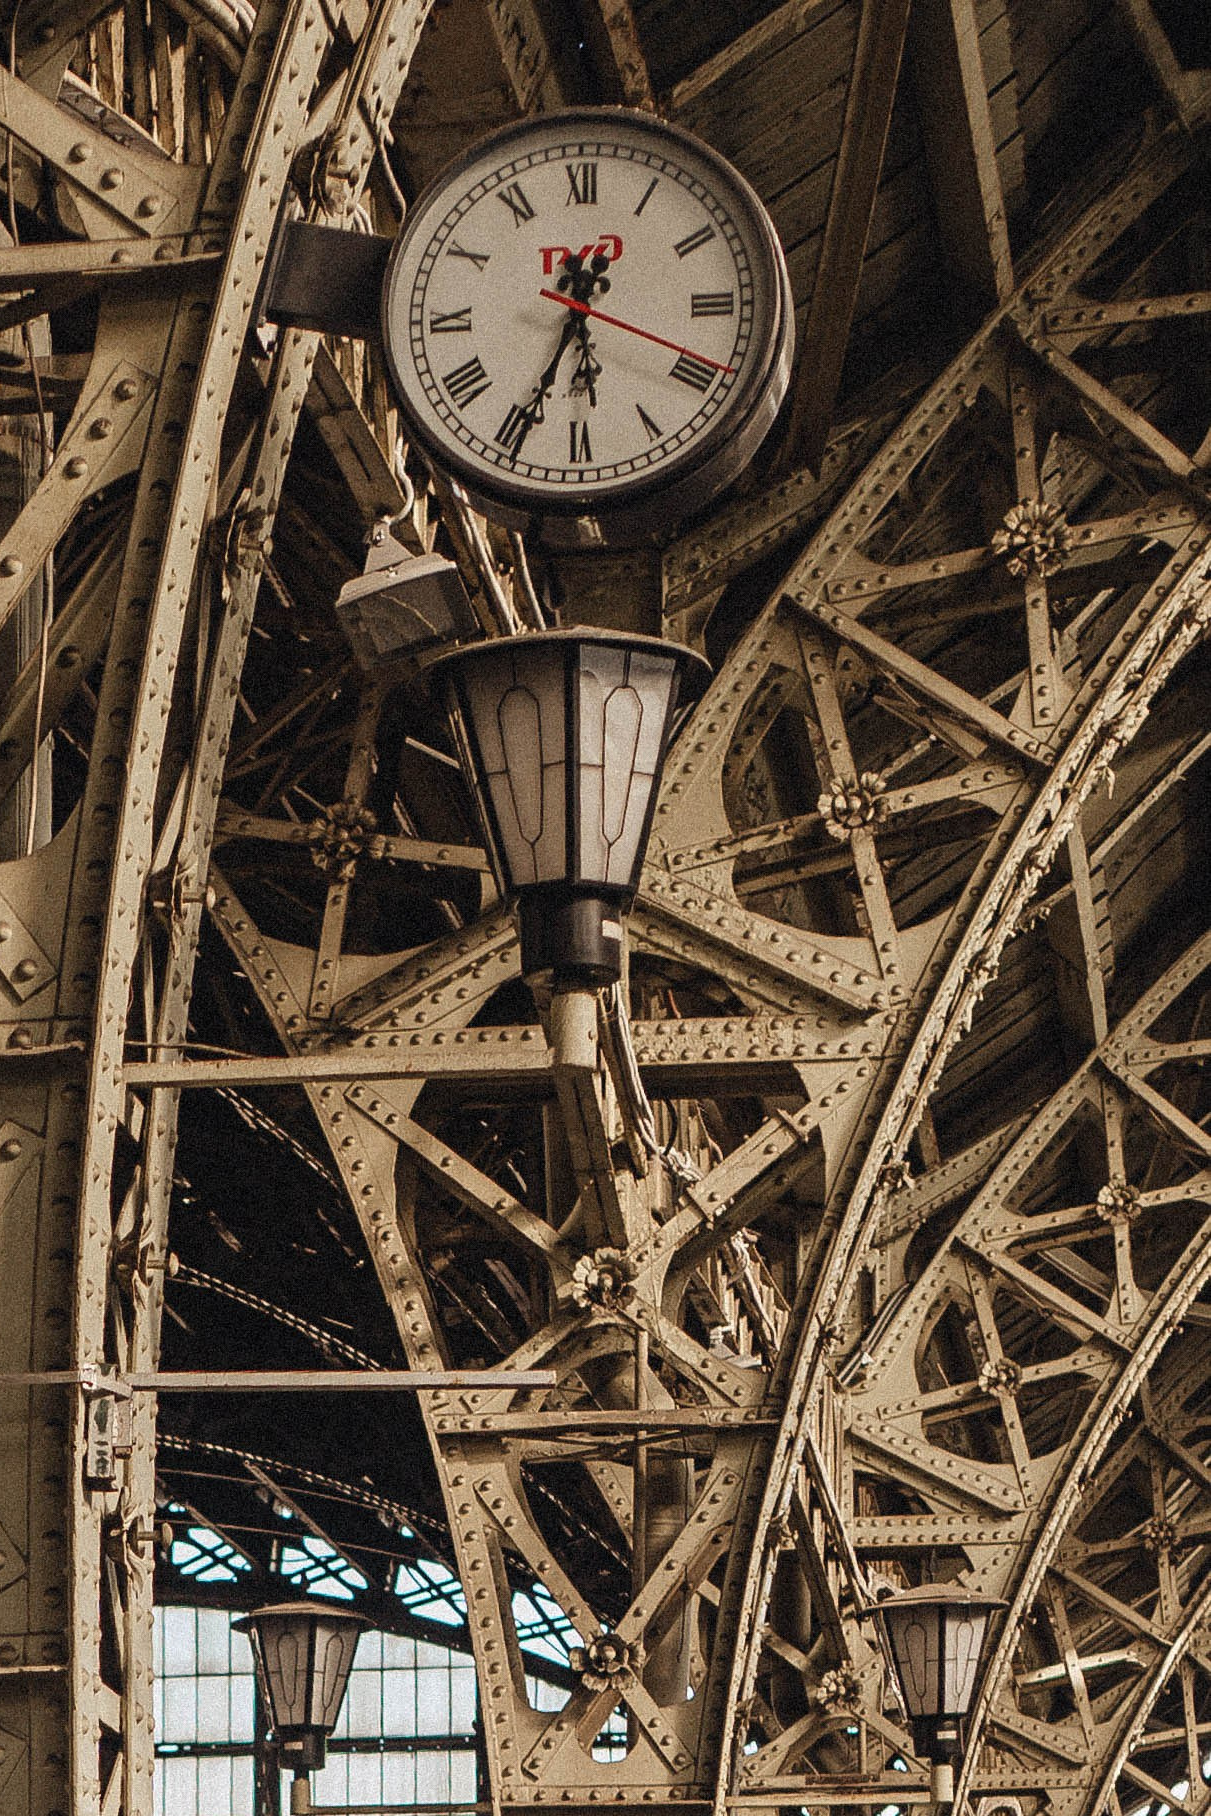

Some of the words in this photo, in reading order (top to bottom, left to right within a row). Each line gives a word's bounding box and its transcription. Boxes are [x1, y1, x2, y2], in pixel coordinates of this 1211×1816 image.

[565, 163, 598, 206] XII
[634, 176, 660, 217] I
[496, 181, 535, 229] XI
[447, 239, 490, 272] X
[673, 223, 717, 260] II
[430, 307, 472, 334] IX
[691, 290, 734, 318] III
[442, 354, 493, 412] VIII
[569, 420, 594, 463] VI
[636, 403, 664, 442] V
